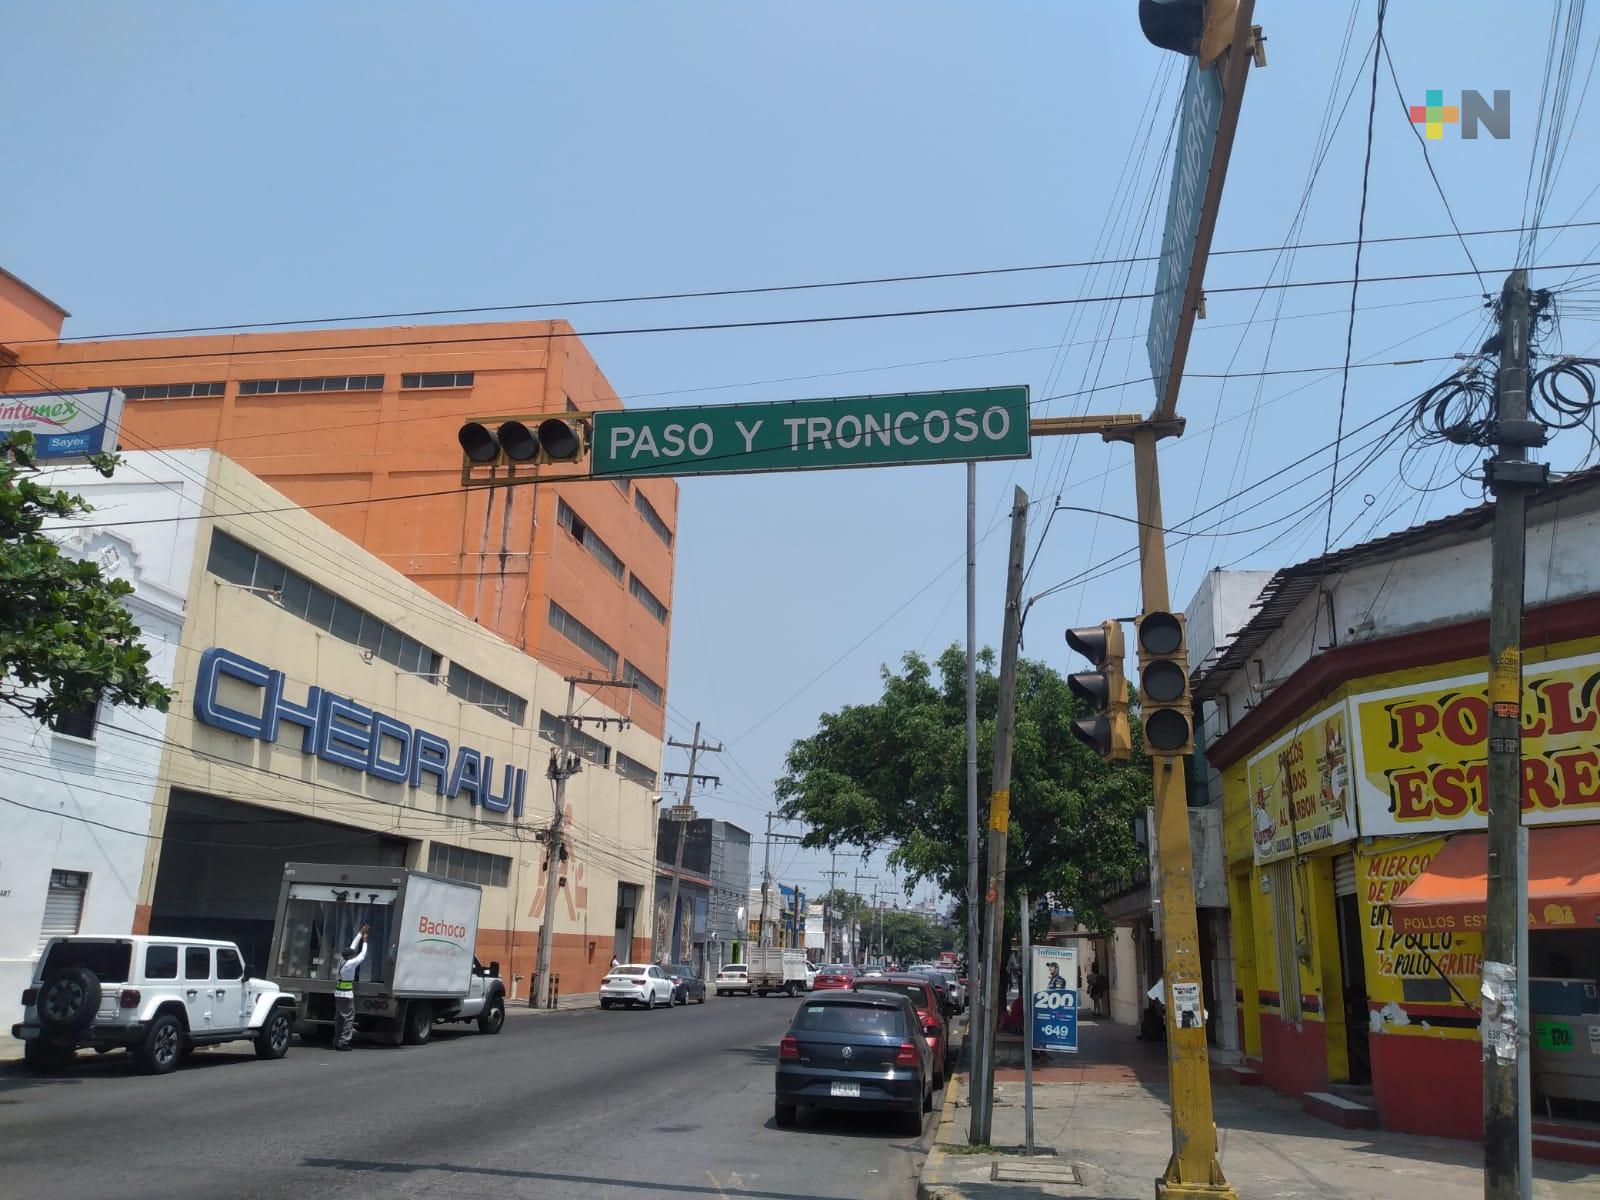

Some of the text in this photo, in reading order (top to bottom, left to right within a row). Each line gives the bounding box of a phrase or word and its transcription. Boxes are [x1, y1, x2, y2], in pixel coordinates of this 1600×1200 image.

[0, 401, 76, 420] intumex
[610, 404, 1010, 460] PASO Y TRONCOSO
[1395, 681, 1600, 753] POL
[194, 646, 526, 818] CHEDRAUI
[1280, 810, 1288, 827] AL
[1291, 794, 1317, 822] ARBON
[1367, 881, 1387, 902] DE
[418, 916, 466, 938] Bachoco
[1404, 915, 1456, 929] POLLOS
[1390, 932, 1452, 951] POLLO
[1394, 954, 1432, 975] POLLO
[1034, 991, 1074, 1010] 200
